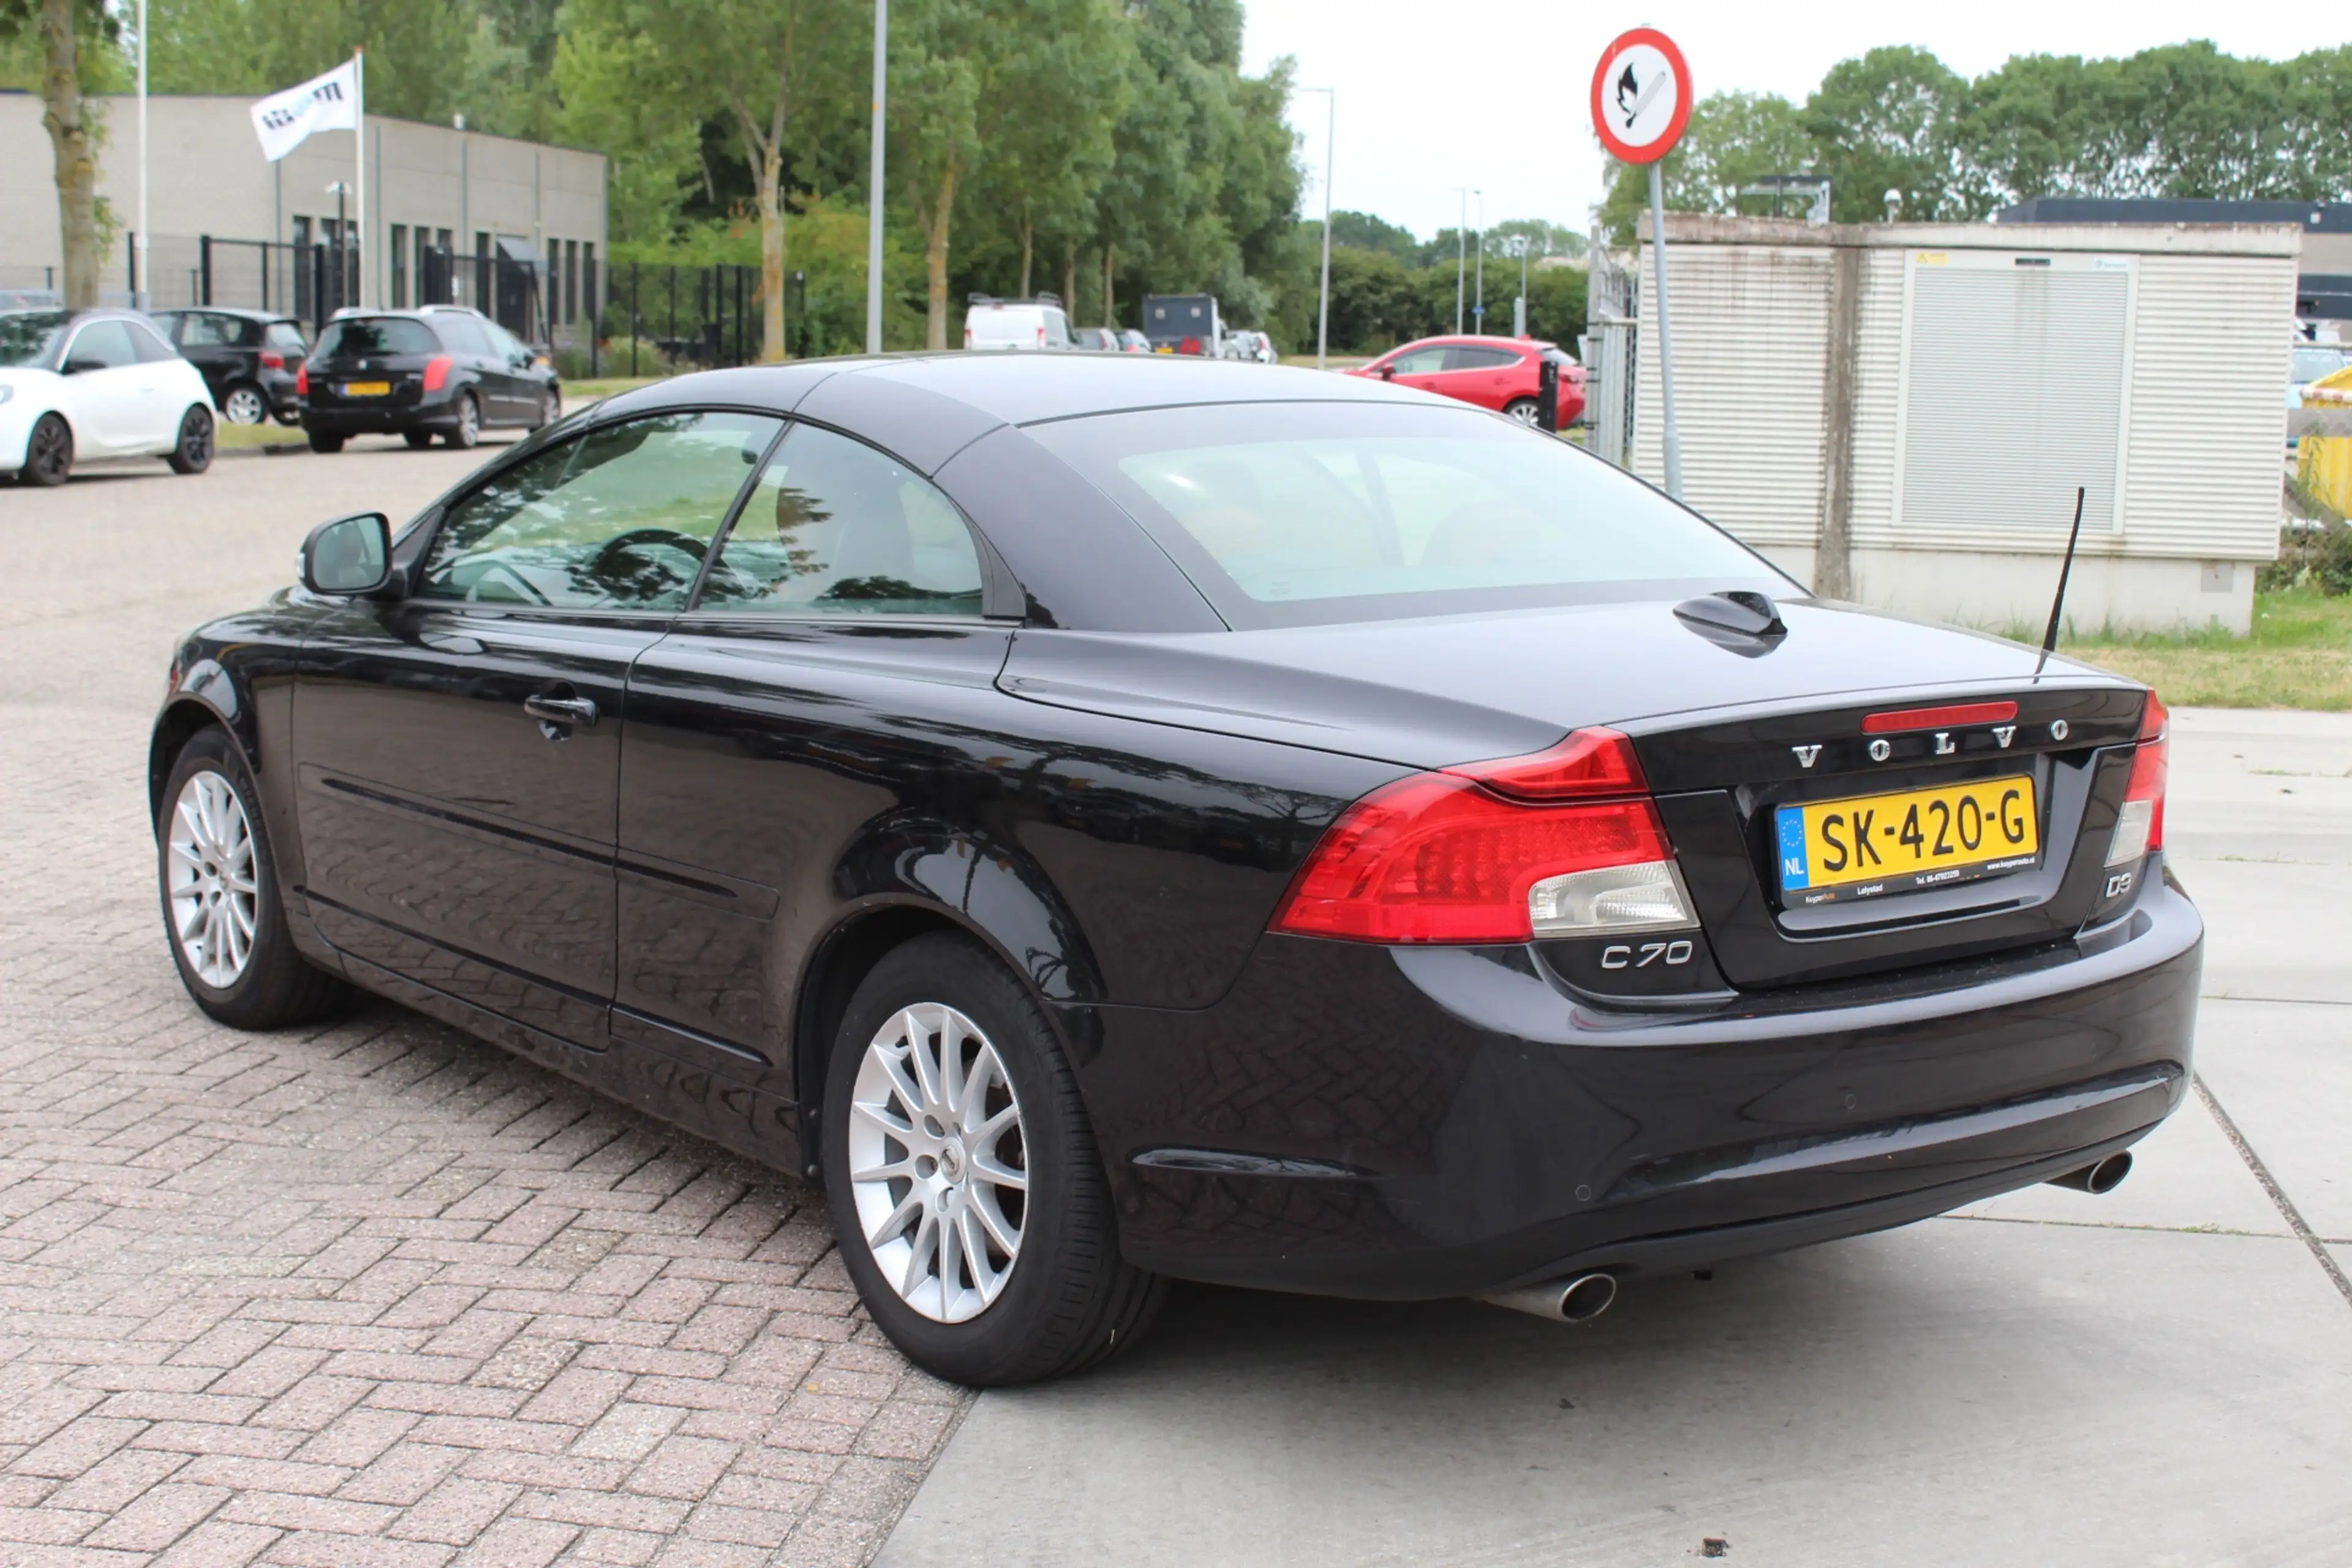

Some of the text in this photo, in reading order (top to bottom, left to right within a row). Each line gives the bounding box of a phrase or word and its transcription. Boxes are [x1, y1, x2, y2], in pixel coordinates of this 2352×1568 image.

[1792, 719, 2068, 768] VOLVO
[1821, 789, 2024, 872] SK-420-G
[1785, 857, 1804, 876] NL
[1601, 940, 1693, 969] C70
